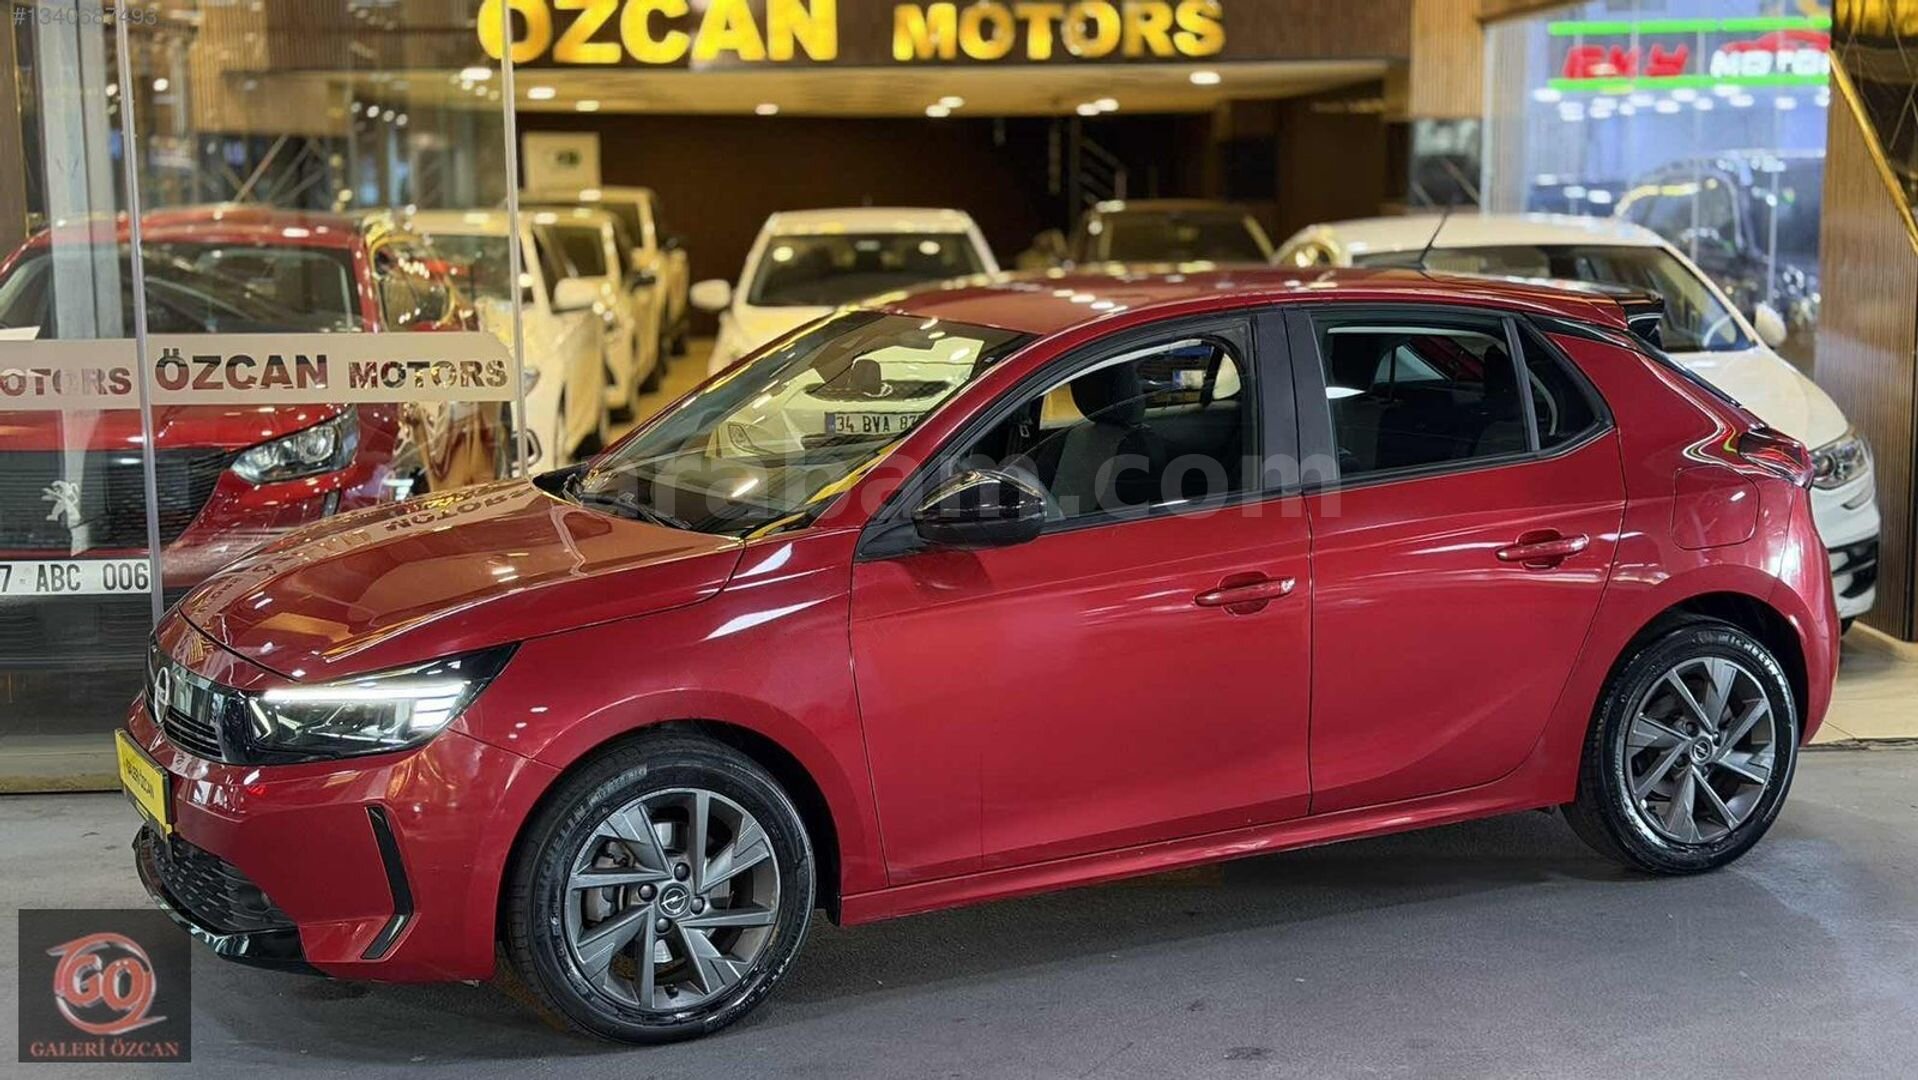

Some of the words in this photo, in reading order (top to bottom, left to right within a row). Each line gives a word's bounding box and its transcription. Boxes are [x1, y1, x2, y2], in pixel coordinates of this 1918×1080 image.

[892, 0, 1227, 61] MOTORS
[0, 367, 132, 397] OTORS
[155, 348, 328, 391] ÖZCAN
[349, 359, 508, 390] MOTORS
[836, 416, 854, 432] 34
[863, 415, 890, 432] BVA
[36, 564, 81, 592] ABC
[102, 563, 149, 590] 006
